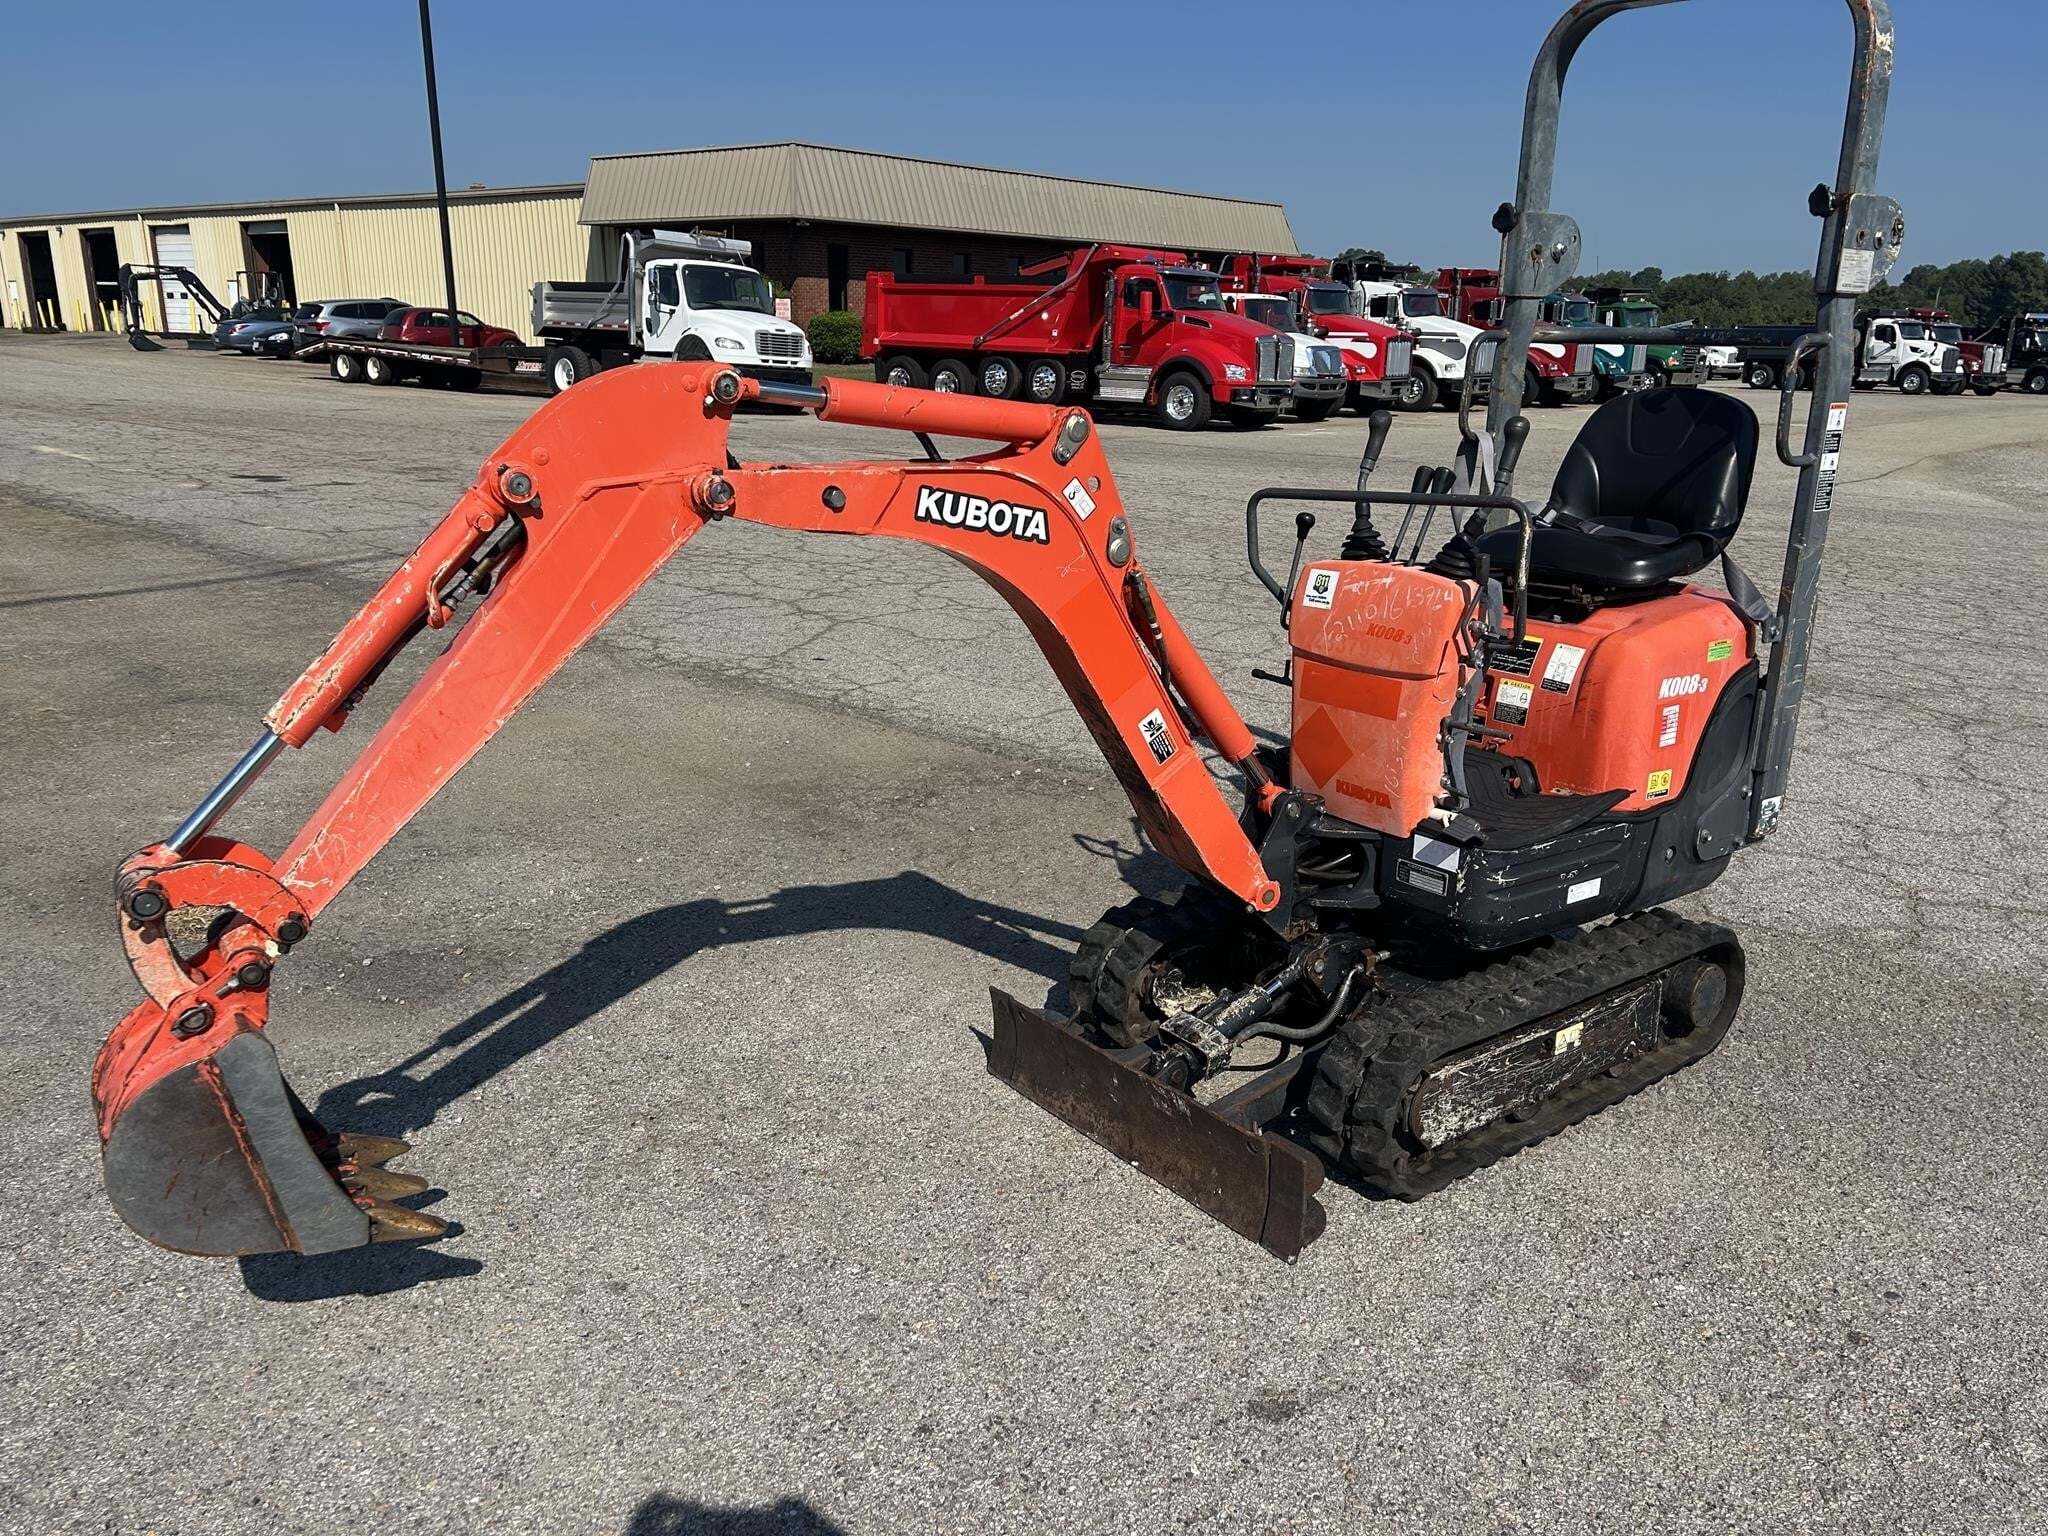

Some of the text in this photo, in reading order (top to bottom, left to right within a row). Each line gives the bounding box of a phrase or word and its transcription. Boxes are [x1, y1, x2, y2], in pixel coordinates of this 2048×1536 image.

[916, 487, 1048, 542] KUBOTA
[1315, 575, 1329, 587] 811
[1366, 622, 1413, 646] K008-3
[1658, 673, 1709, 699] K008-3
[1335, 778, 1393, 809] KUBOTA
